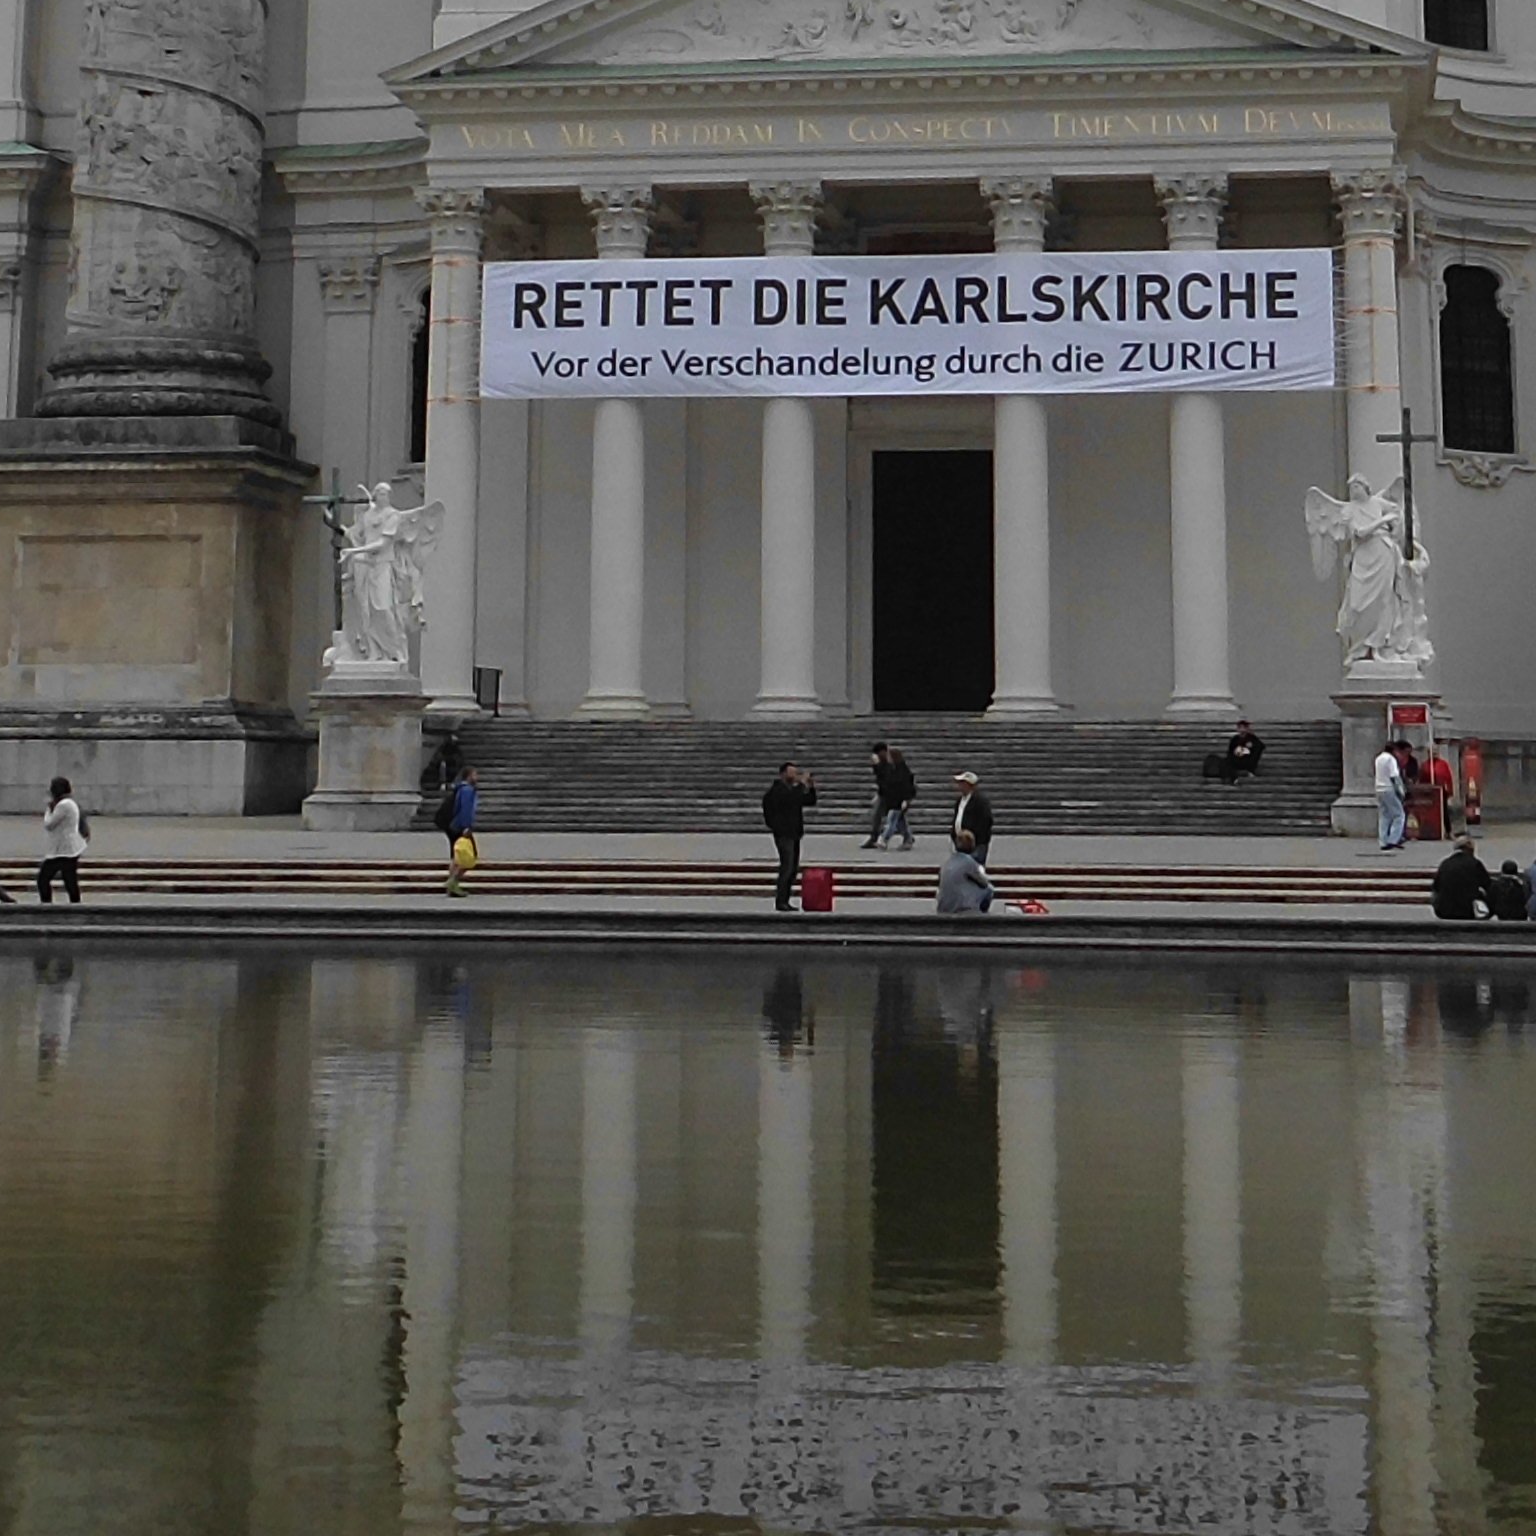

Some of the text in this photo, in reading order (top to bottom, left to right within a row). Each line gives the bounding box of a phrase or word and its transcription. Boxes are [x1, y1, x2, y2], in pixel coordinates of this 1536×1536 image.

[513, 270, 1299, 328] RETTET DIE KARLSKIRCHE
[531, 340, 1277, 382] Vor der Verschandelung durch die ZURICH
